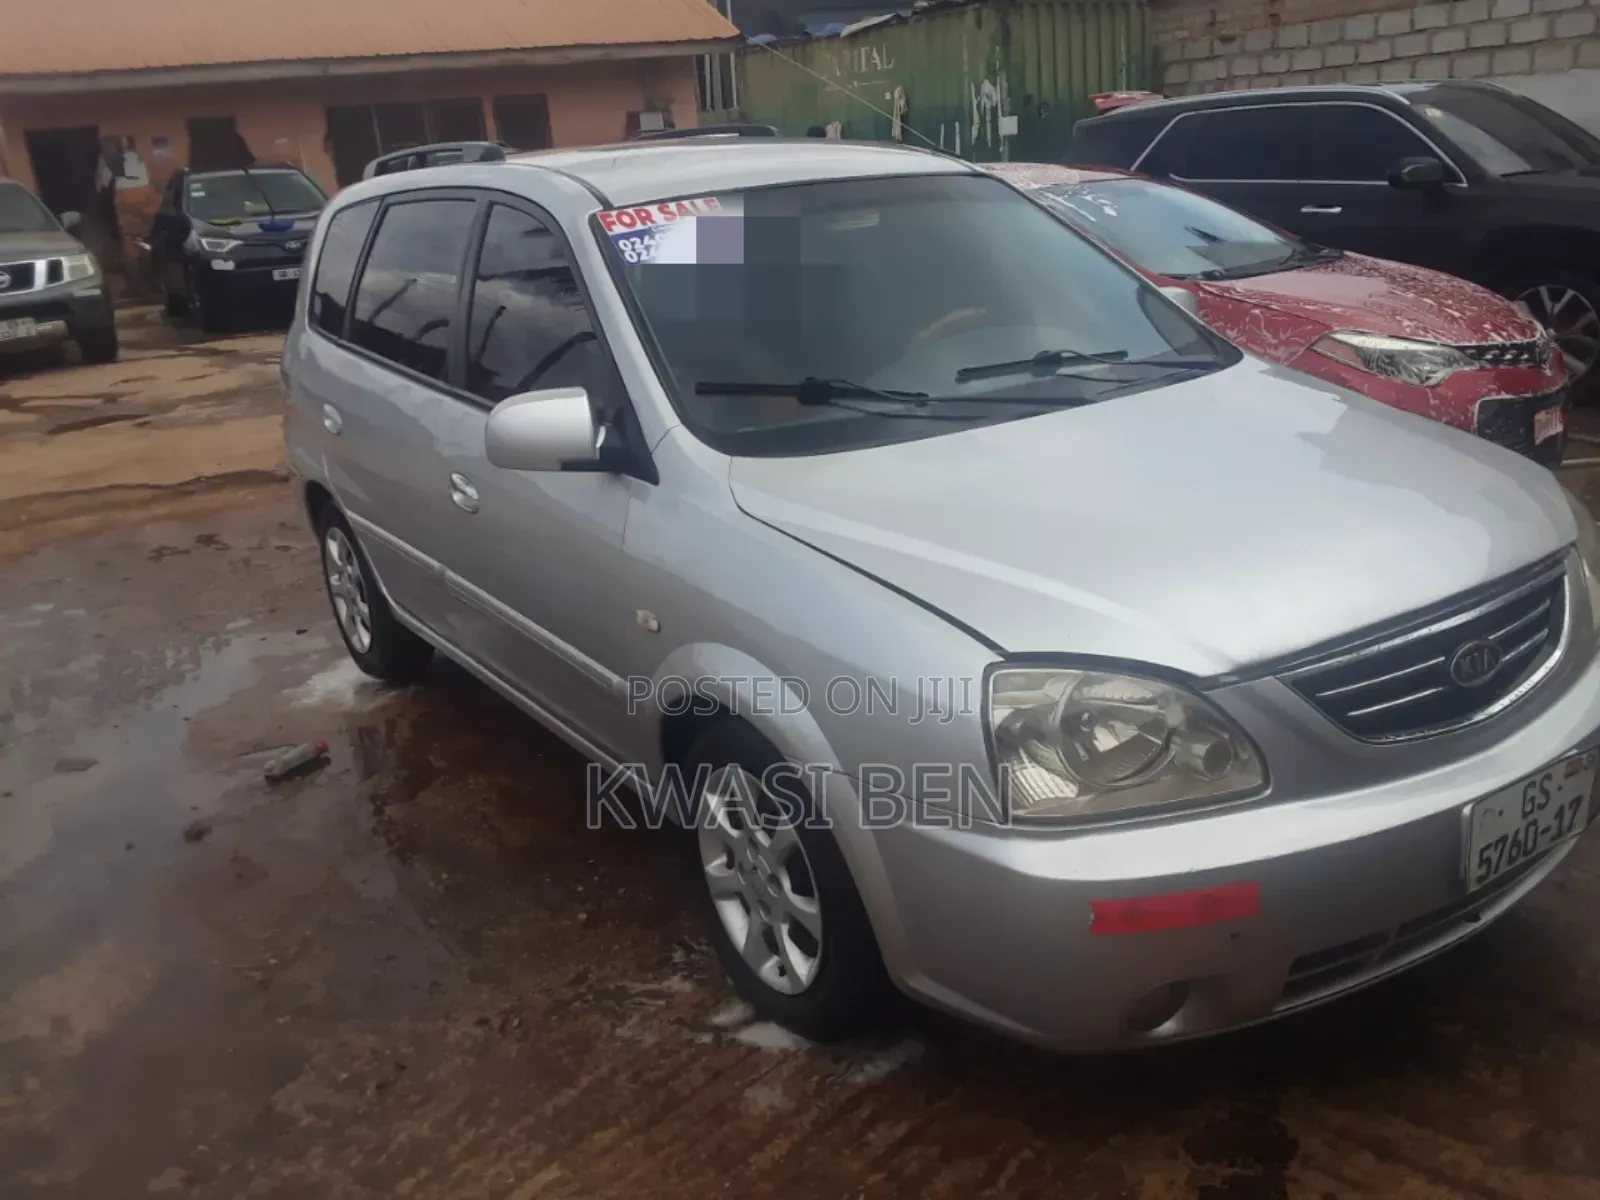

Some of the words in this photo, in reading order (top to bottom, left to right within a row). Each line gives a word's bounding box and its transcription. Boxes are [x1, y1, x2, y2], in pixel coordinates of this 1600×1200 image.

[598, 207, 658, 233] FOR
[658, 196, 719, 221] SALE
[1521, 773, 1553, 820] GS
[1476, 794, 1584, 885] 5760-17
